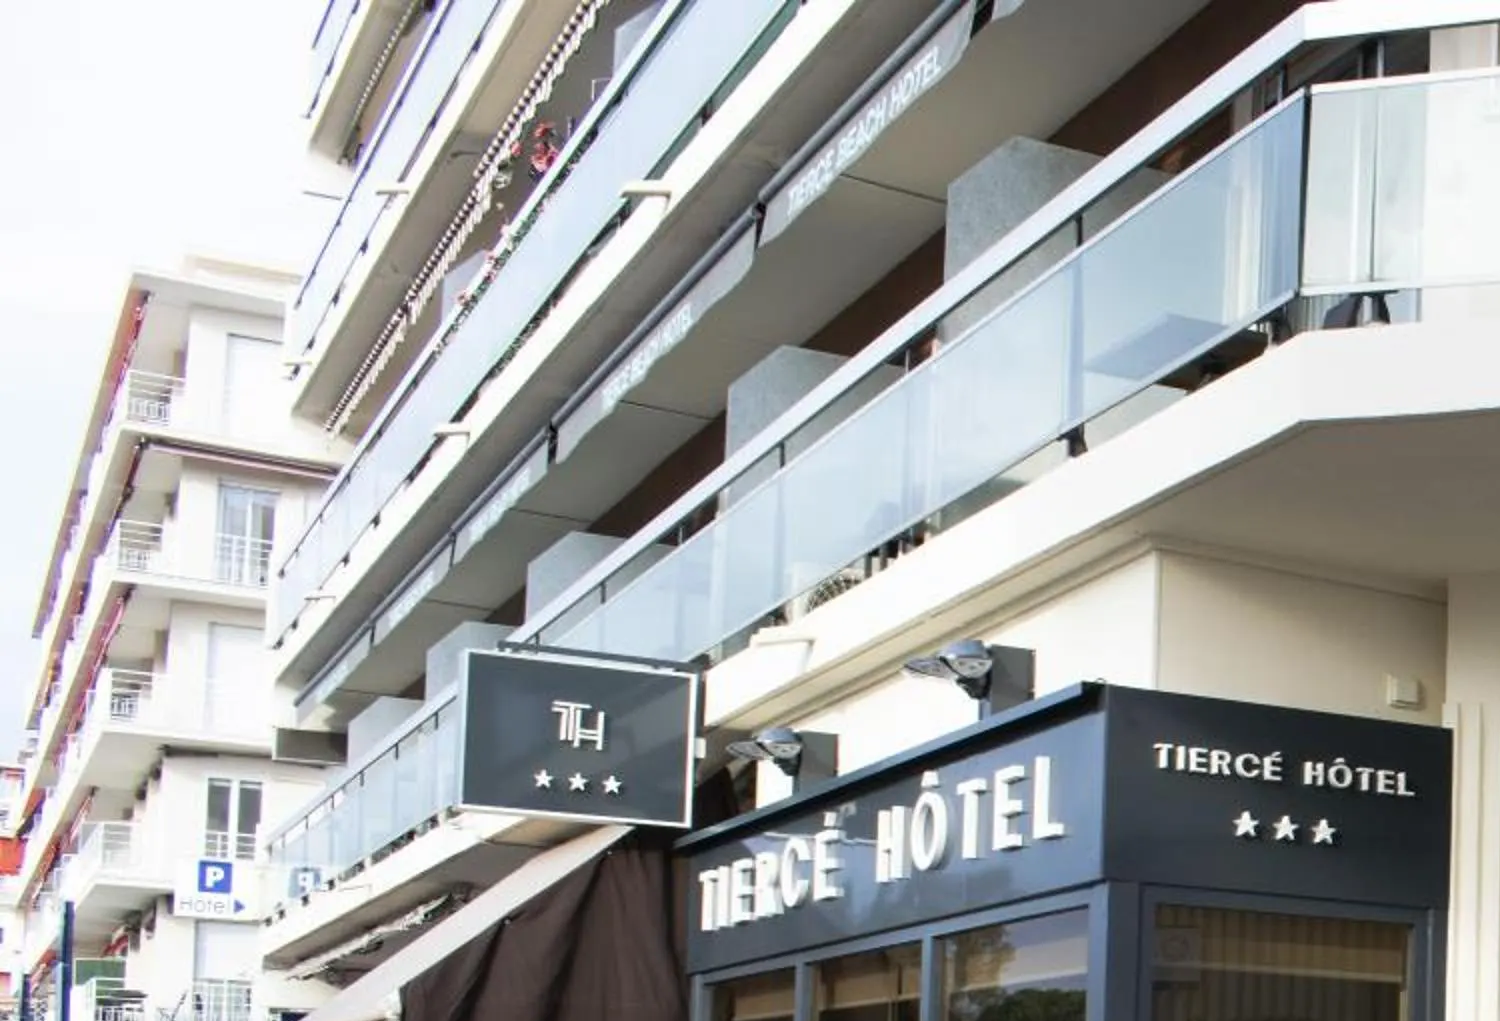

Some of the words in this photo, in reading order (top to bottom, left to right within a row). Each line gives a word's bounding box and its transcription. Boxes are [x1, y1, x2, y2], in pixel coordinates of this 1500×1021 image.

[552, 700, 604, 750] TH
[1153, 743, 1283, 781] TIERCÉ
[1303, 757, 1416, 797] HÔTEL
[699, 811, 845, 931] TIERCÉ
[876, 756, 1065, 883] HÔTEL
[205, 866, 225, 888] P
